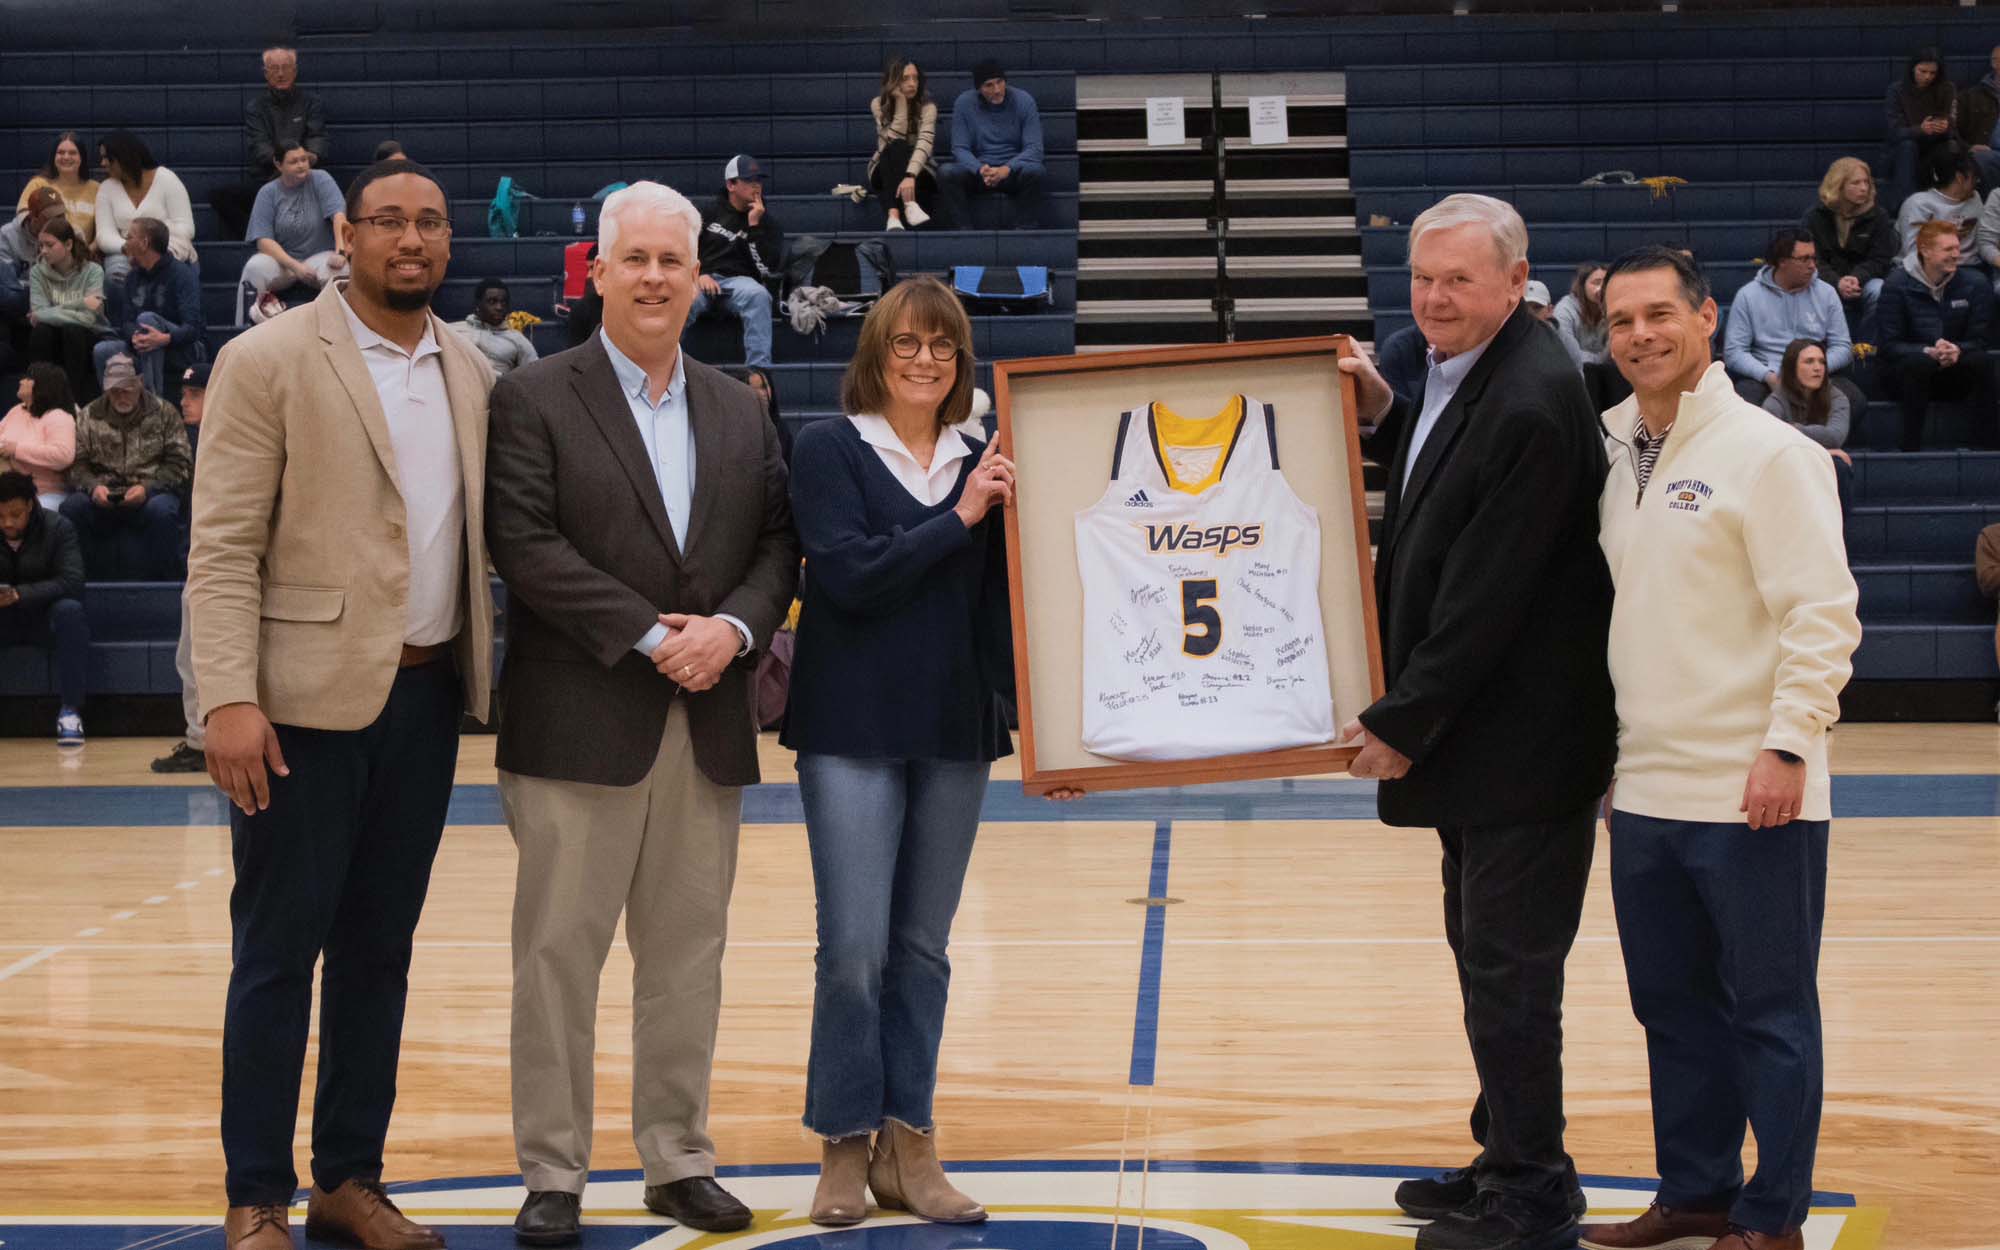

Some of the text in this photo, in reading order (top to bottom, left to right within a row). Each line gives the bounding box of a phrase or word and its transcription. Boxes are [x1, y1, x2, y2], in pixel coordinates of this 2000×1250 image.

[1124, 500, 1154, 509] adidas
[1668, 501, 1700, 512] COLLEGE
[1143, 523, 1263, 557] Wasps
[1182, 579, 1222, 657] 5
